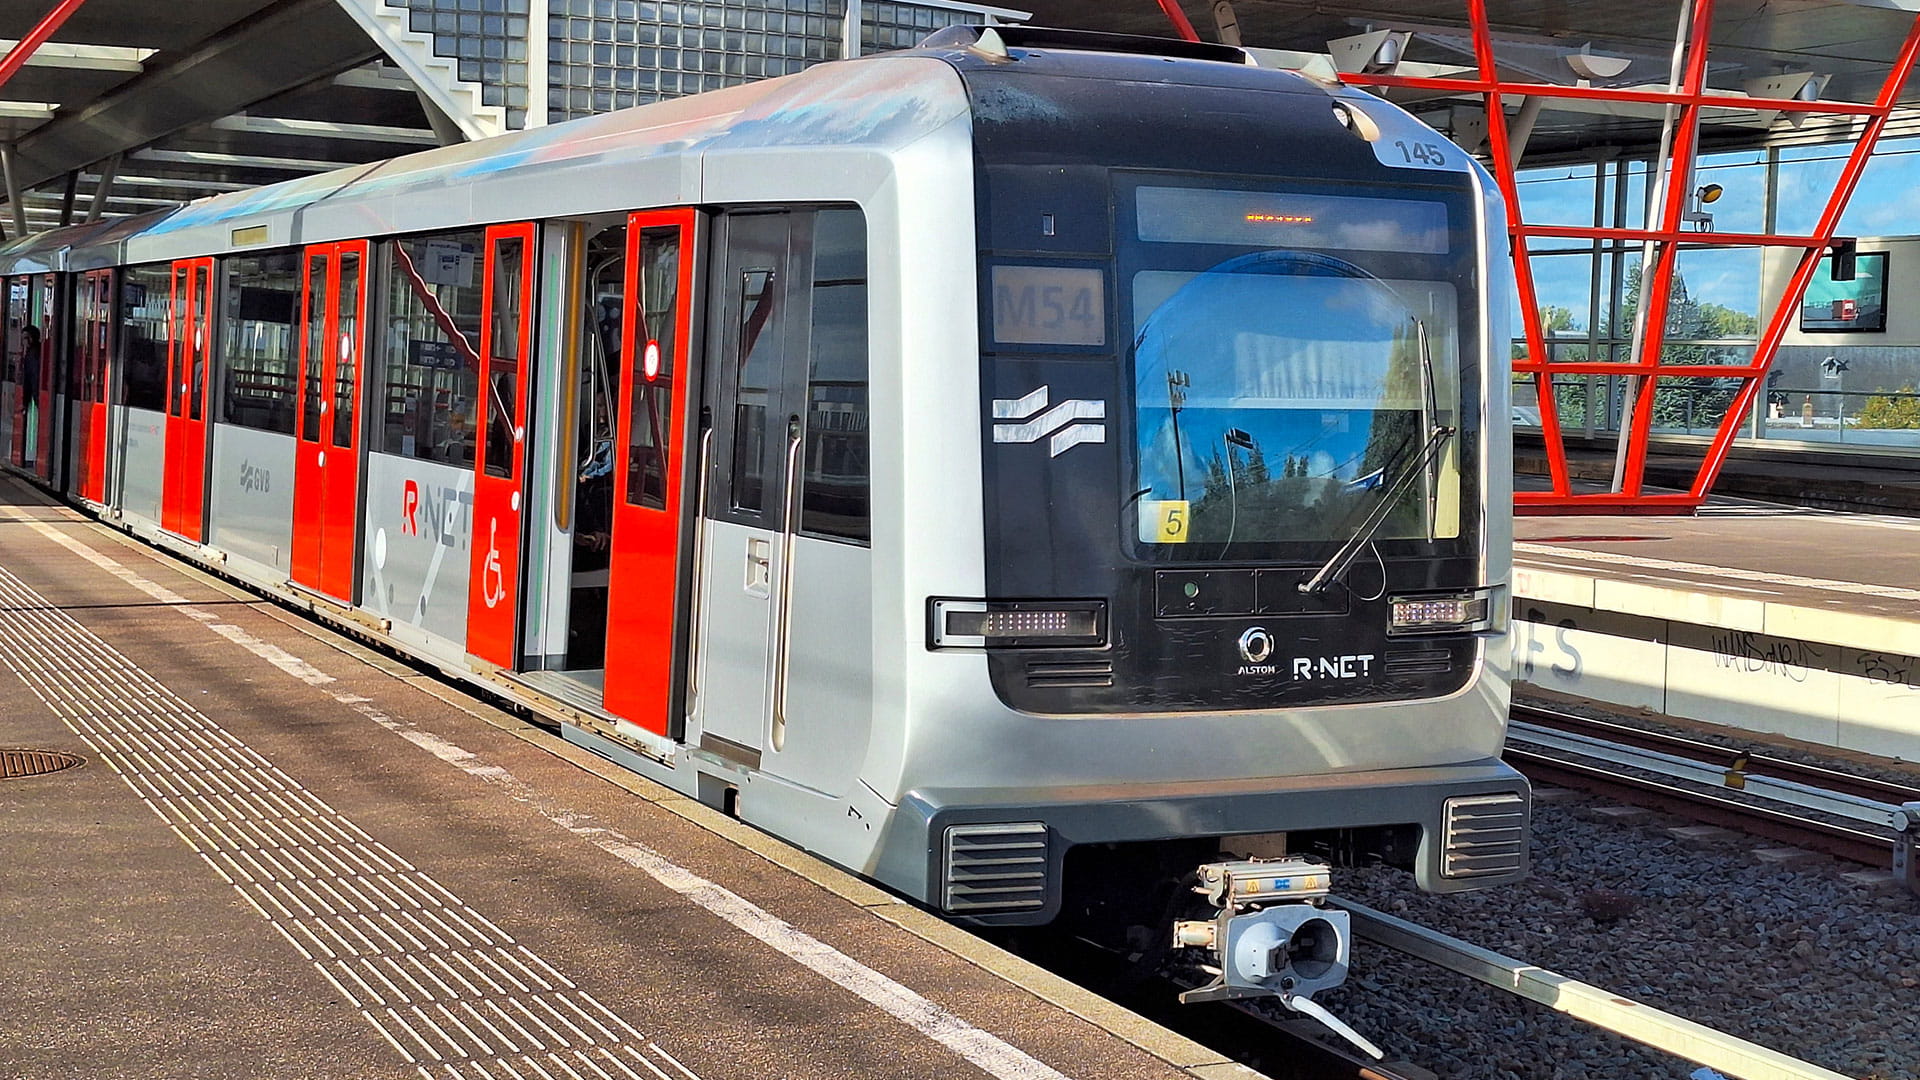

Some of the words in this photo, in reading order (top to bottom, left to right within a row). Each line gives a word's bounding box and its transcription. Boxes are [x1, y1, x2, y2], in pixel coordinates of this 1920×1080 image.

[1395, 141, 1446, 166] 145
[997, 285, 1096, 328] M54
[254, 467, 270, 493] GVB
[1166, 509, 1182, 535] 5
[1238, 665, 1275, 675] ALSTOM
